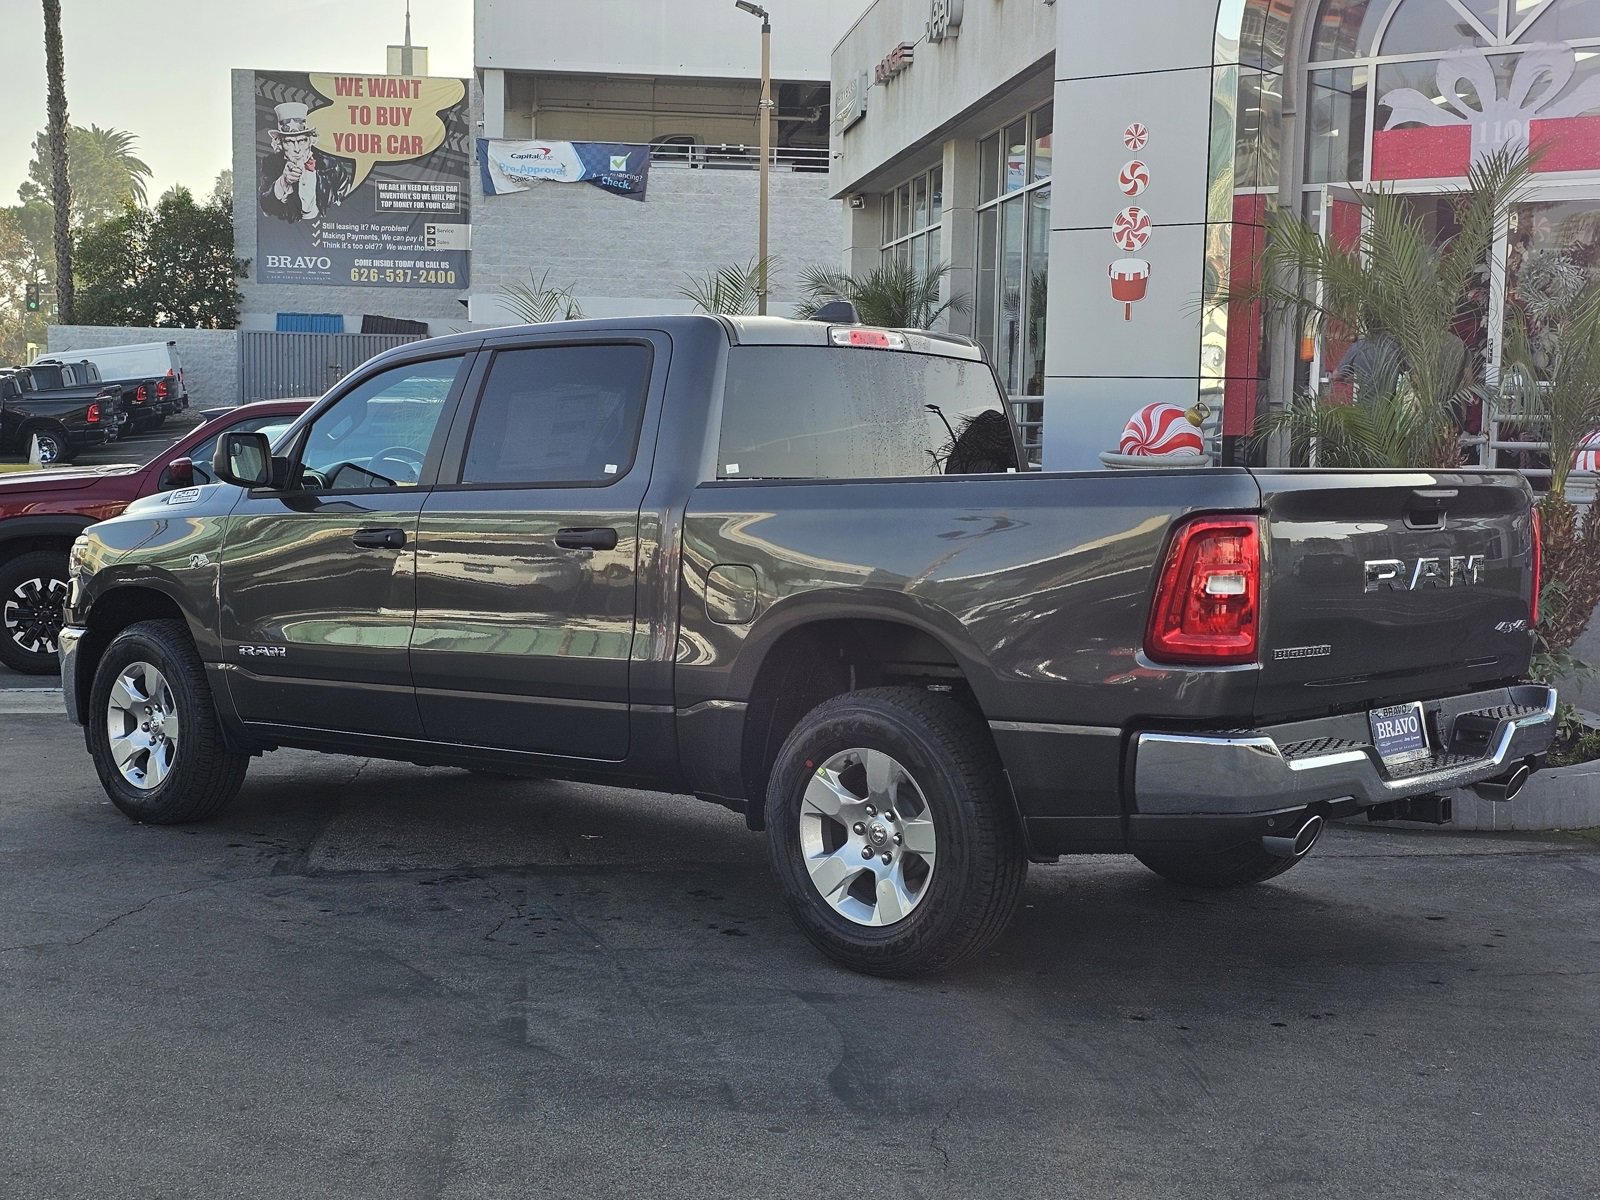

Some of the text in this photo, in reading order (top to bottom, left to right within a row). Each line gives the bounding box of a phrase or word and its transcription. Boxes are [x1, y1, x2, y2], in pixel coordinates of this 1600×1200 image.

[334, 77, 421, 99] WE WANT
[348, 105, 412, 126] TO BUY
[333, 133, 423, 155] YOUR CAR
[601, 176, 632, 190] Check.
[336, 224, 360, 232] leasing
[322, 232, 346, 240] Making
[346, 232, 380, 242] Payments,
[266, 256, 331, 270] BRAVO
[395, 260, 414, 268] TODAY
[350, 268, 456, 284] 626-537-2400
[1364, 554, 1485, 594] RAM
[239, 645, 286, 657] RAM
[1273, 645, 1331, 660] BIGHORN
[1383, 705, 1407, 717] BRAVO
[1376, 716, 1418, 739] BRAVO
